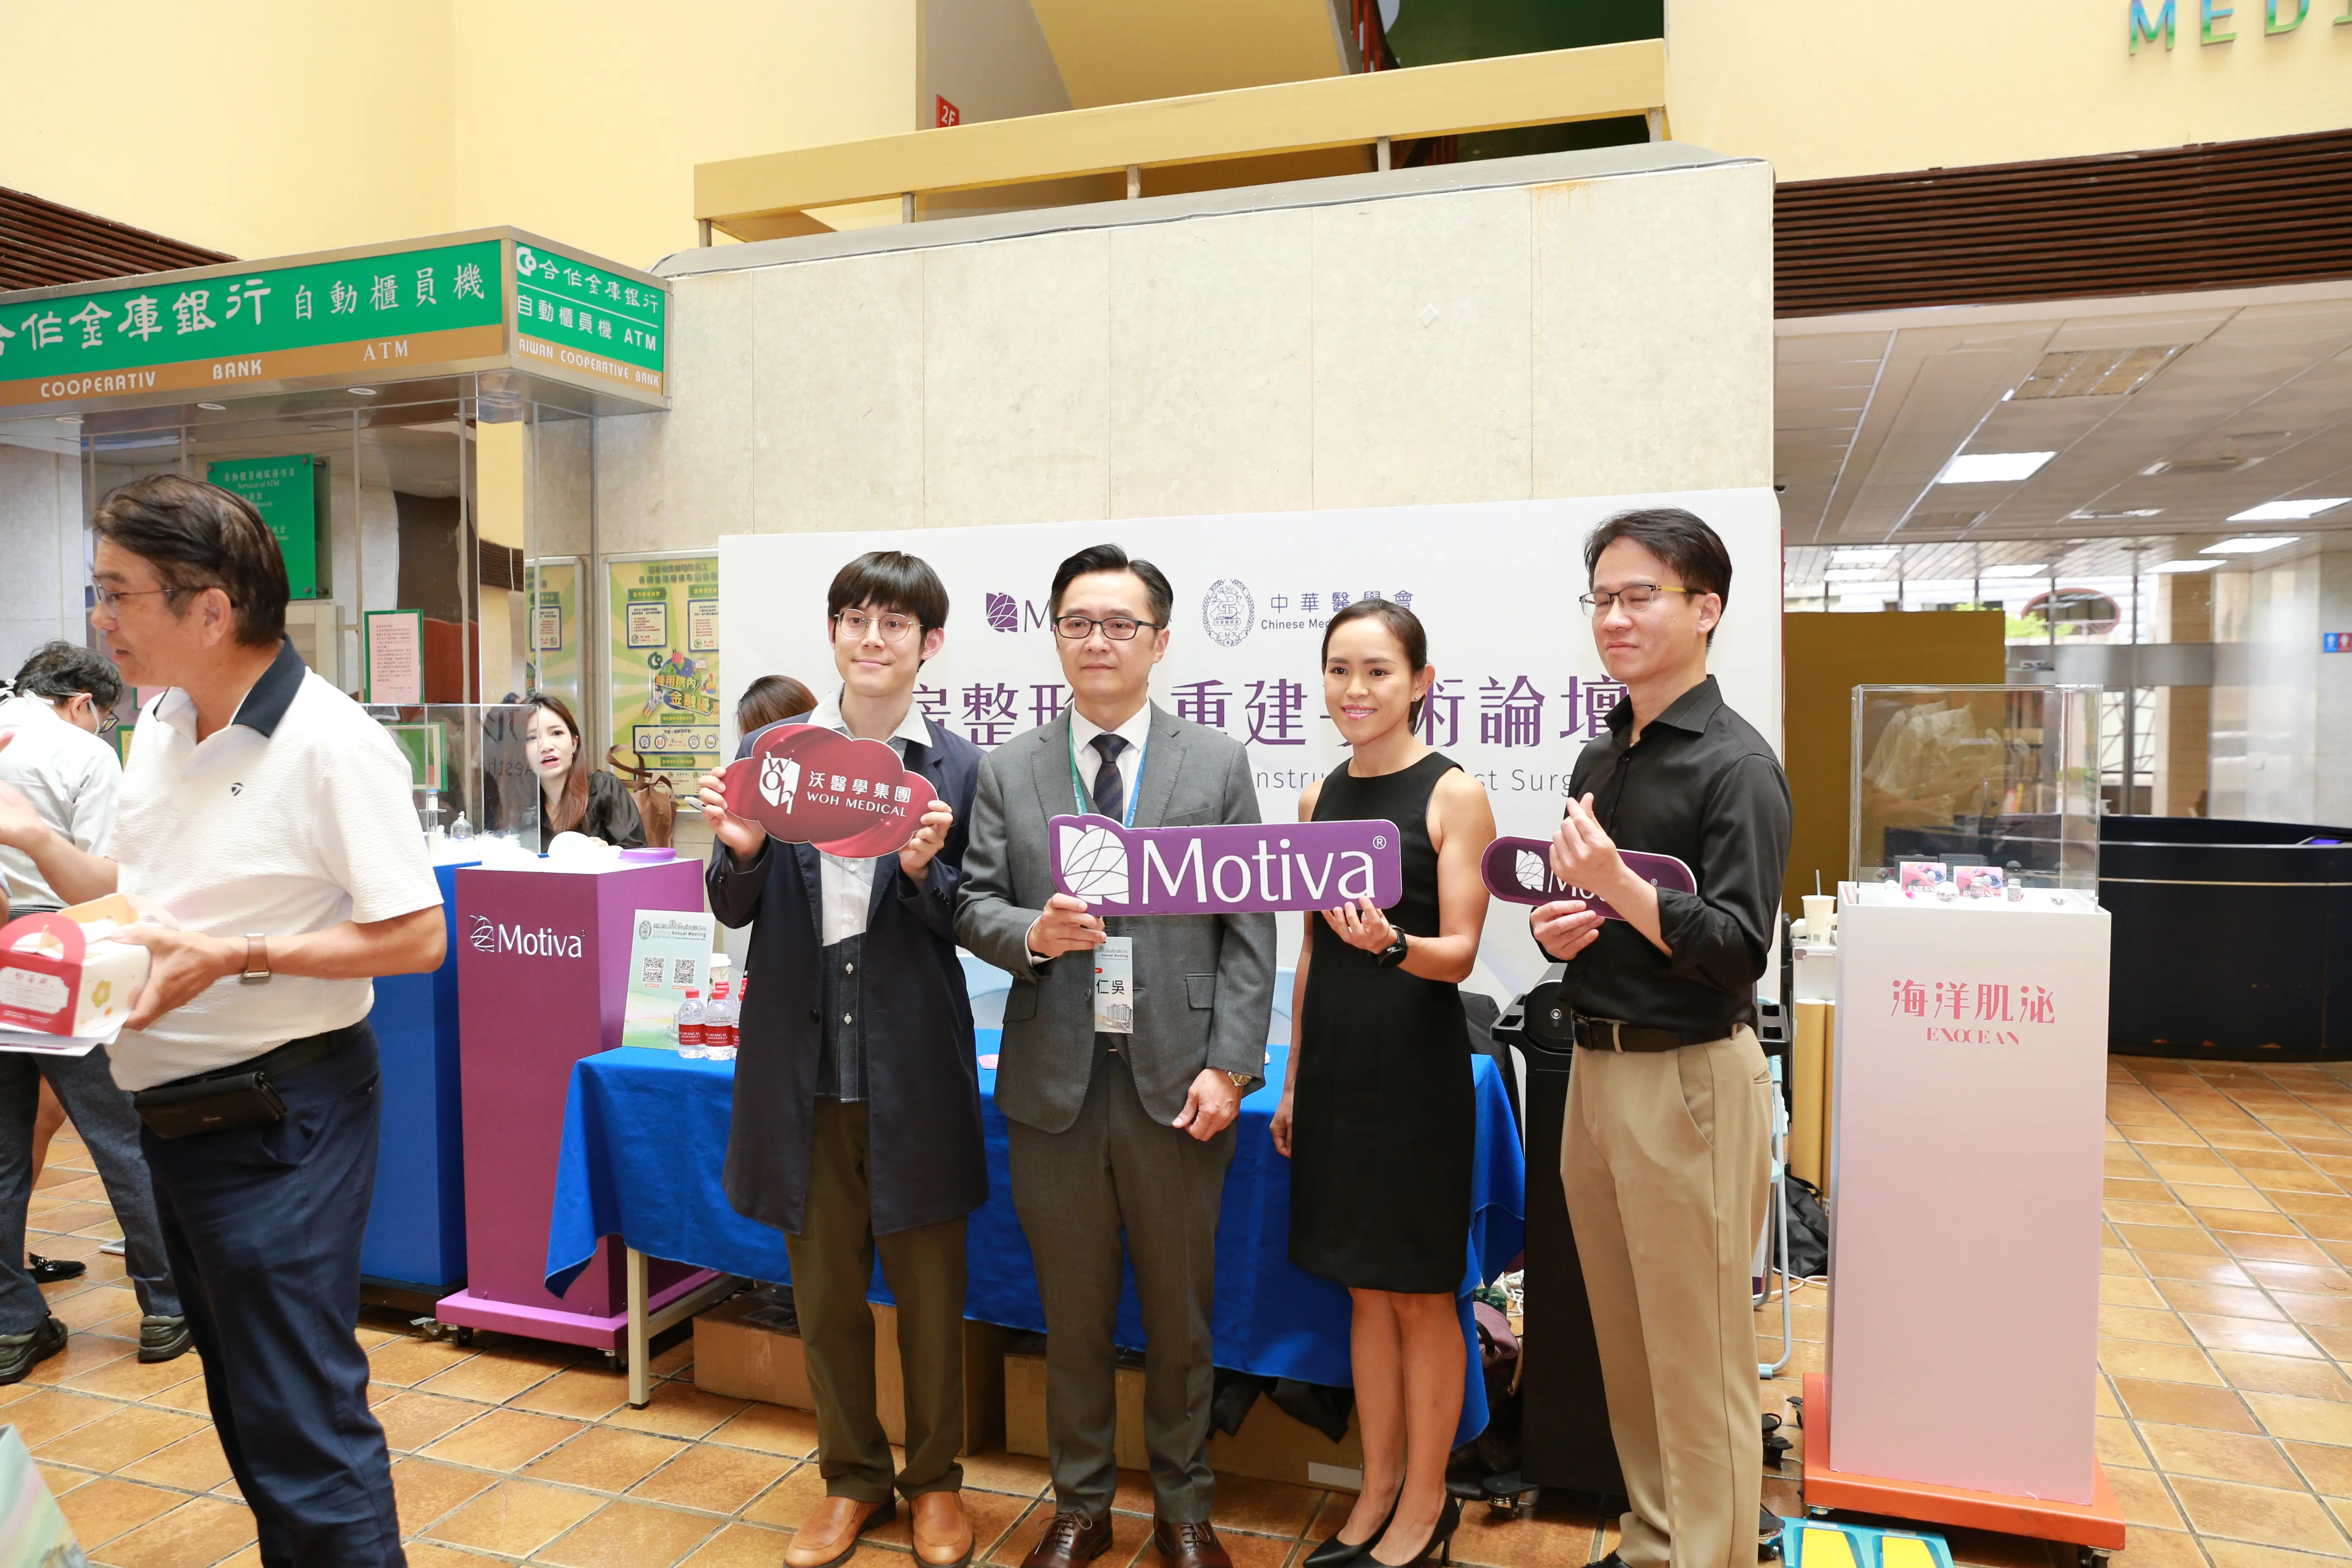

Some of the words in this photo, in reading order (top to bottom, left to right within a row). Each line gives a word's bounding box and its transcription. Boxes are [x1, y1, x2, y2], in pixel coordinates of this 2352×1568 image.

[2130, 0, 2352, 55] MED
[941, 105, 956, 126] 2F
[294, 263, 485, 320] 自動櫃員機
[539, 259, 658, 314] 合作金庫銀行
[518, 294, 612, 340] 自動櫃員機
[624, 328, 656, 352] ATM
[40, 371, 156, 398] COOPERATIV
[213, 358, 262, 380] BANK
[363, 340, 409, 361] ATM
[561, 349, 629, 379] COOPERATIVE
[635, 371, 659, 387] BANK
[1261, 619, 1305, 629] Chinese
[807, 791, 839, 806] WOH
[845, 797, 907, 818] MEDICAL
[808, 770, 912, 803] 沃醫學集團
[499, 923, 582, 958] Motiva
[1927, 1027, 2019, 1045] EXOCEAN
